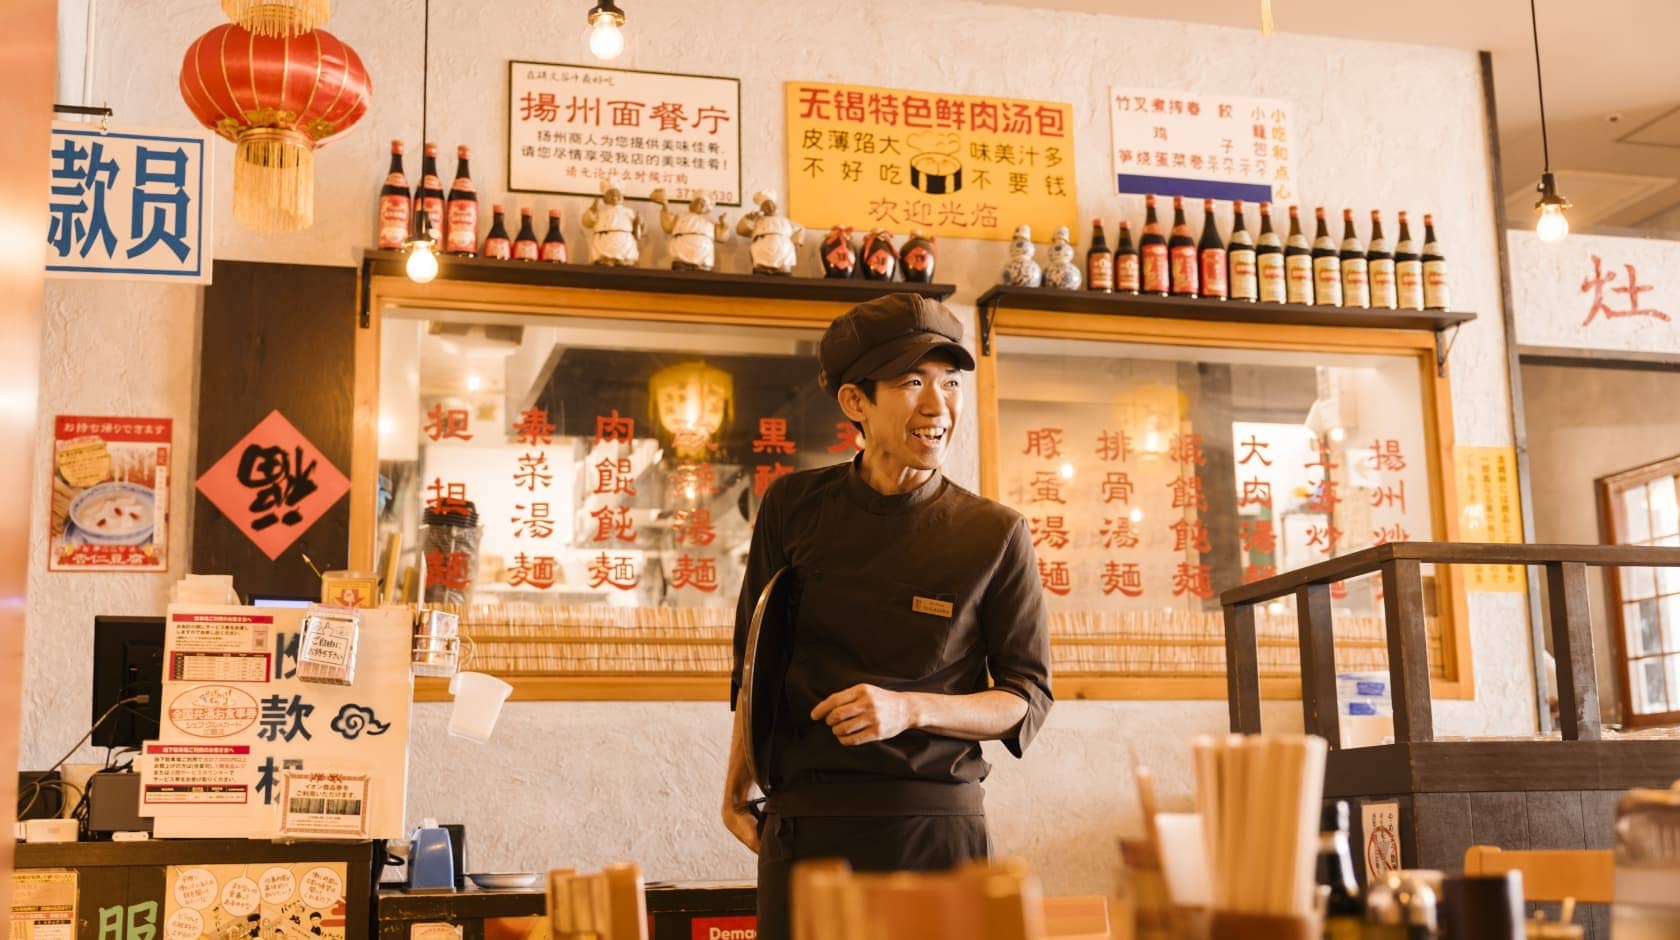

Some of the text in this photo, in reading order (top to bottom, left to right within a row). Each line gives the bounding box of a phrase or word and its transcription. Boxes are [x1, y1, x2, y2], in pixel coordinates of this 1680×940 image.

[520, 91, 730, 135] 揚州面餐厅
[799, 87, 1065, 138] 无锡特色鲜肉汤包
[802, 128, 901, 155] 皮薄馅大
[970, 141, 1064, 168] 味美汁多
[47, 138, 191, 264] 款员
[868, 197, 999, 228] 欢迎光临
[709, 927, 757, 940] Dema
